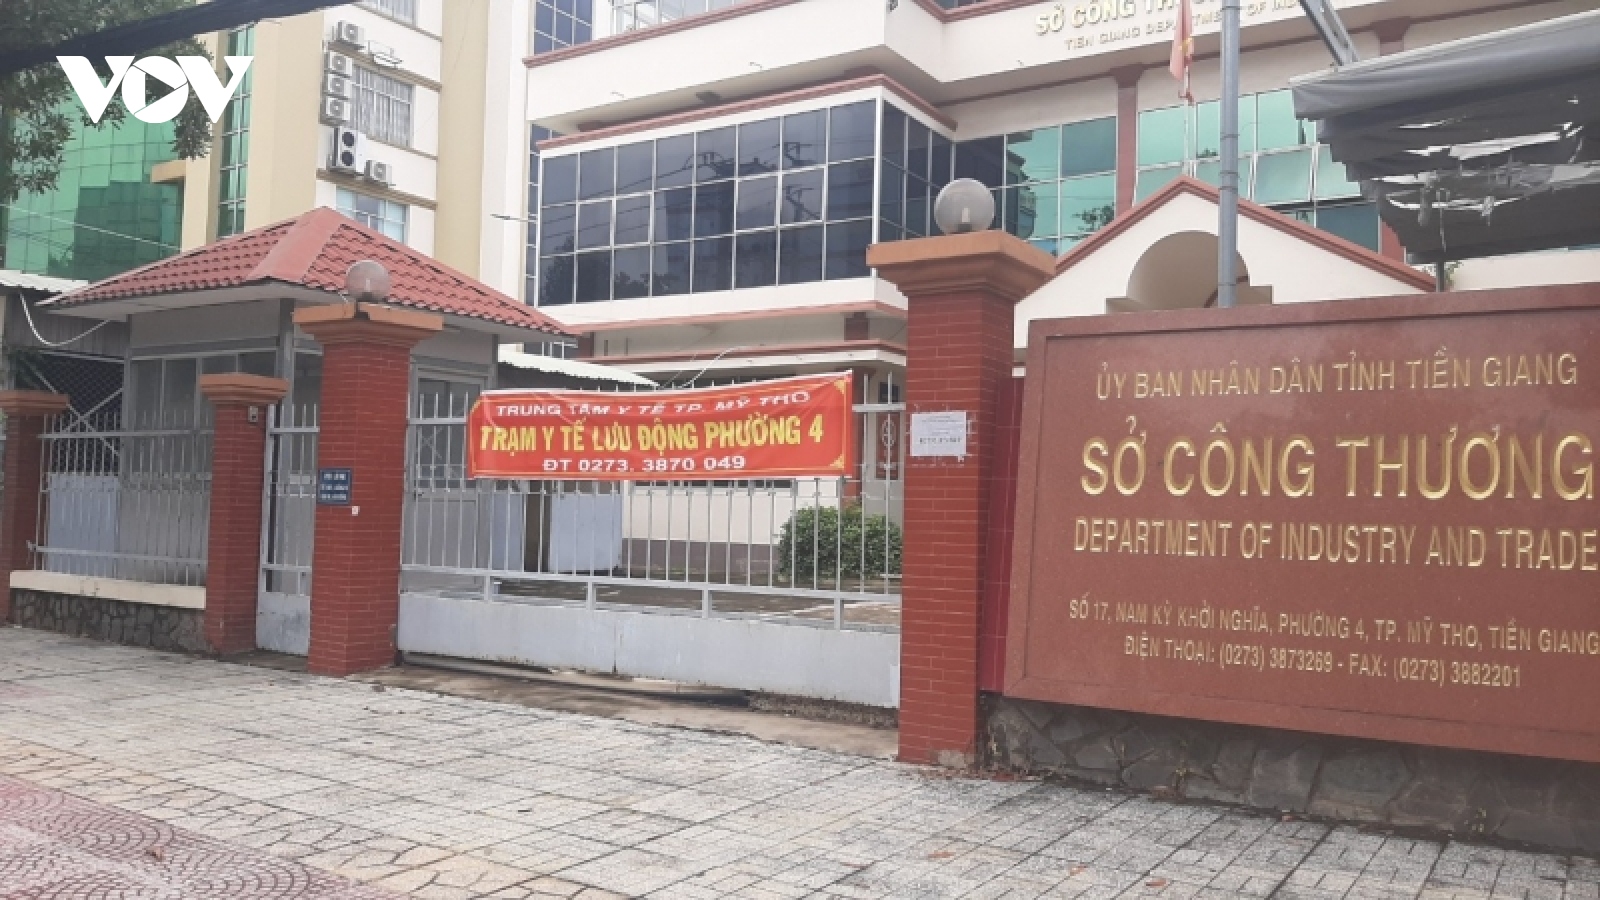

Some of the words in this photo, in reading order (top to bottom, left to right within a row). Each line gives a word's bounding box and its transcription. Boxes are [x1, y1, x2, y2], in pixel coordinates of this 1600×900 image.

[1096, 361, 1126, 400] ỦY
[1134, 371, 1183, 398] BAN
[1191, 359, 1261, 397] NHÂN
[1269, 356, 1325, 394] DÂN
[1331, 350, 1395, 391] TỈNH
[1405, 346, 1471, 389] TIỀN
[1483, 353, 1577, 386] GIANG
[496, 404, 561, 416] TRUNG
[617, 405, 632, 415] Y
[759, 391, 811, 406] THO
[479, 425, 537, 457] TRẠM
[541, 425, 555, 451] Y
[560, 416, 587, 451] TẾ
[638, 417, 699, 457] ĐỘNG
[703, 411, 801, 449] PHƯỜNG
[807, 413, 824, 443] 4
[1080, 414, 1147, 496] SỞ
[1163, 421, 1315, 498] CÔNG
[1336, 423, 1594, 500] THƯƠNG
[541, 459, 573, 471] ĐT
[641, 457, 696, 472] 3870
[703, 455, 747, 471] 049
[1074, 515, 1232, 557] DEPARTMENT
[1239, 521, 1273, 559] OF
[1281, 521, 1417, 564] INDUSTRY
[1424, 524, 1487, 567] AND
[1496, 527, 1599, 572] TRADE
[1069, 591, 1091, 620] SỐ
[1093, 600, 1112, 624] 17,
[1116, 601, 1148, 623] NAM
[1152, 599, 1173, 626] KỲ
[1354, 617, 1369, 643] 4,
[1407, 615, 1434, 645] MỸ
[1538, 626, 1600, 655] GIANG
[1124, 629, 1161, 661] ĐIỆN
[1164, 638, 1215, 666] THOẠI:
[1220, 642, 1265, 672] (0273)
[1349, 653, 1387, 677] FAX:
[1394, 657, 1445, 688] (0273)
